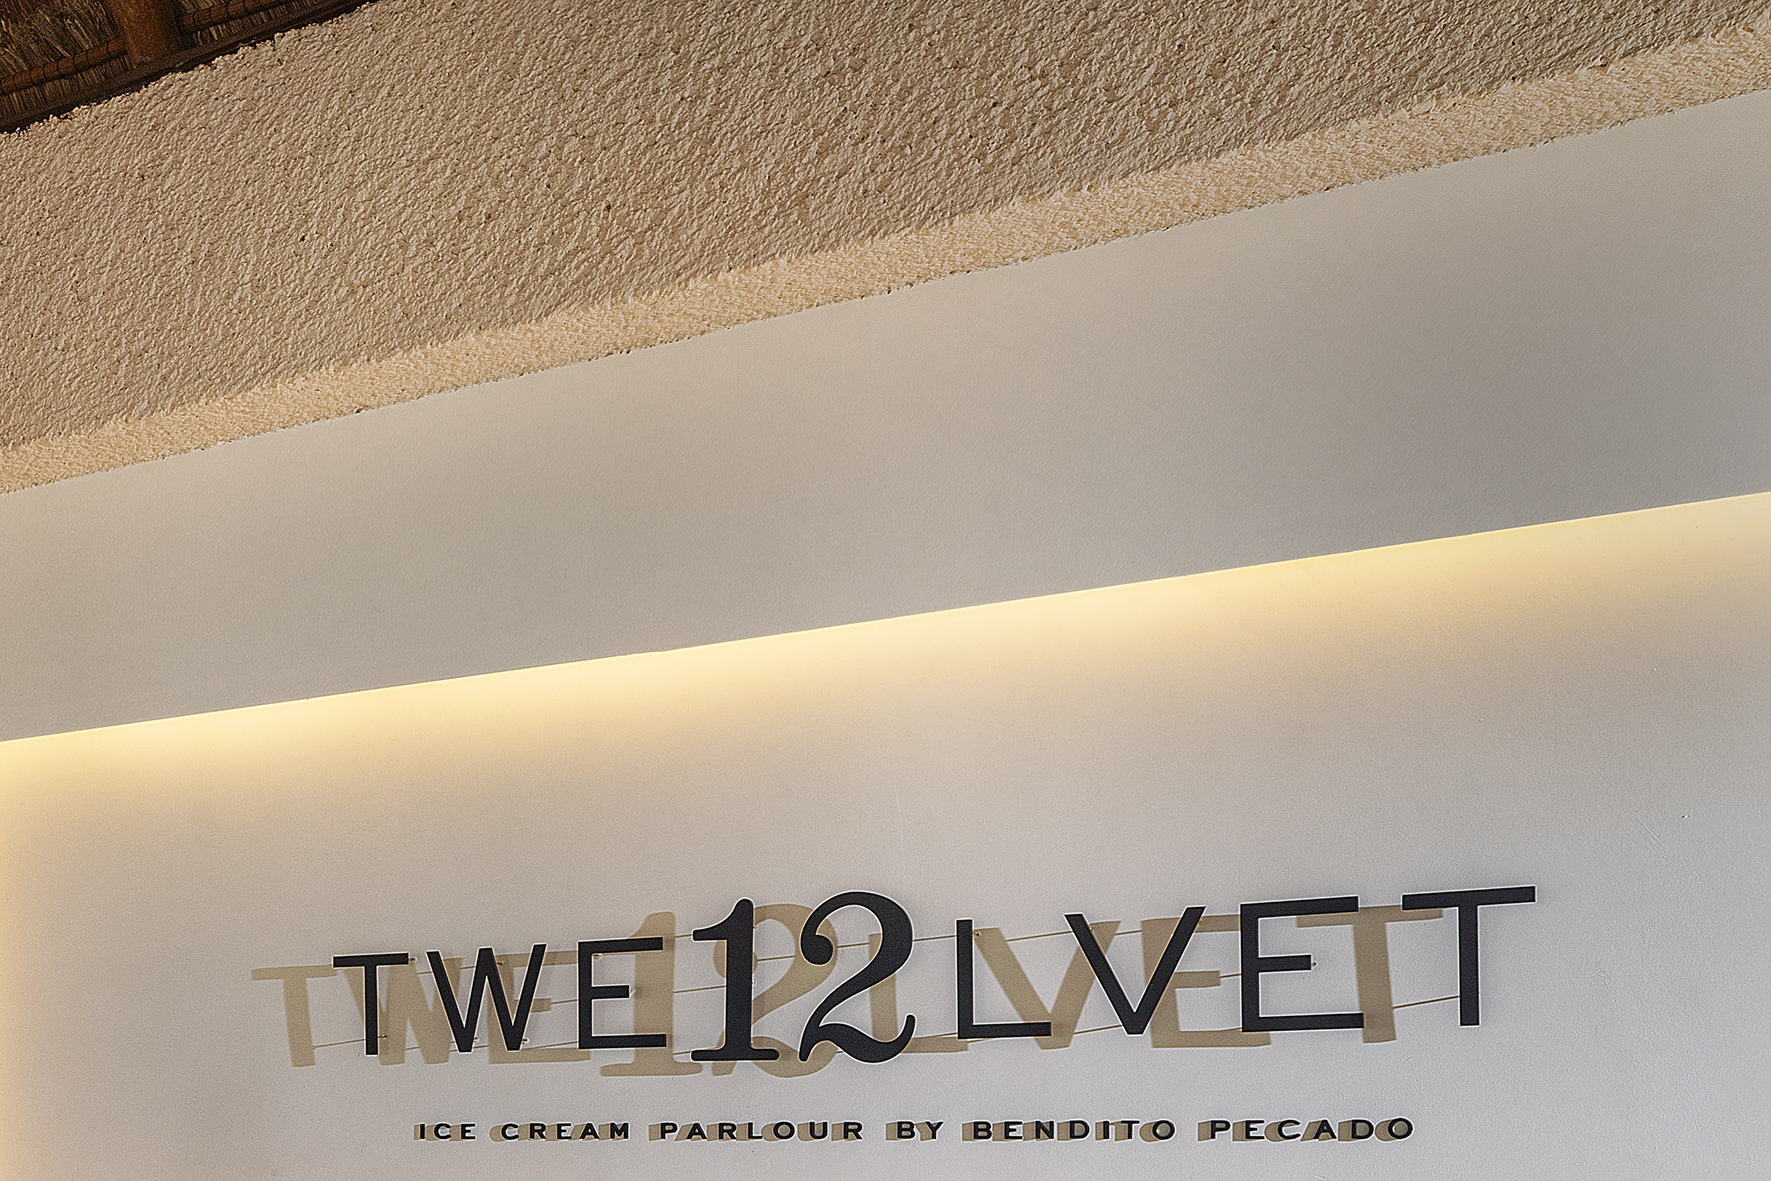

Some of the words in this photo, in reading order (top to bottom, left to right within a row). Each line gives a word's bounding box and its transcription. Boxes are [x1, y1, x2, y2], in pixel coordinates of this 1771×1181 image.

[419, 1123, 477, 1140] ICE
[500, 1122, 629, 1140] CREAM
[660, 1121, 864, 1140] PARLOUR
[896, 1121, 944, 1139] BY
[972, 1119, 1176, 1140] BENDITO
[1209, 1117, 1414, 1140] PECADO
